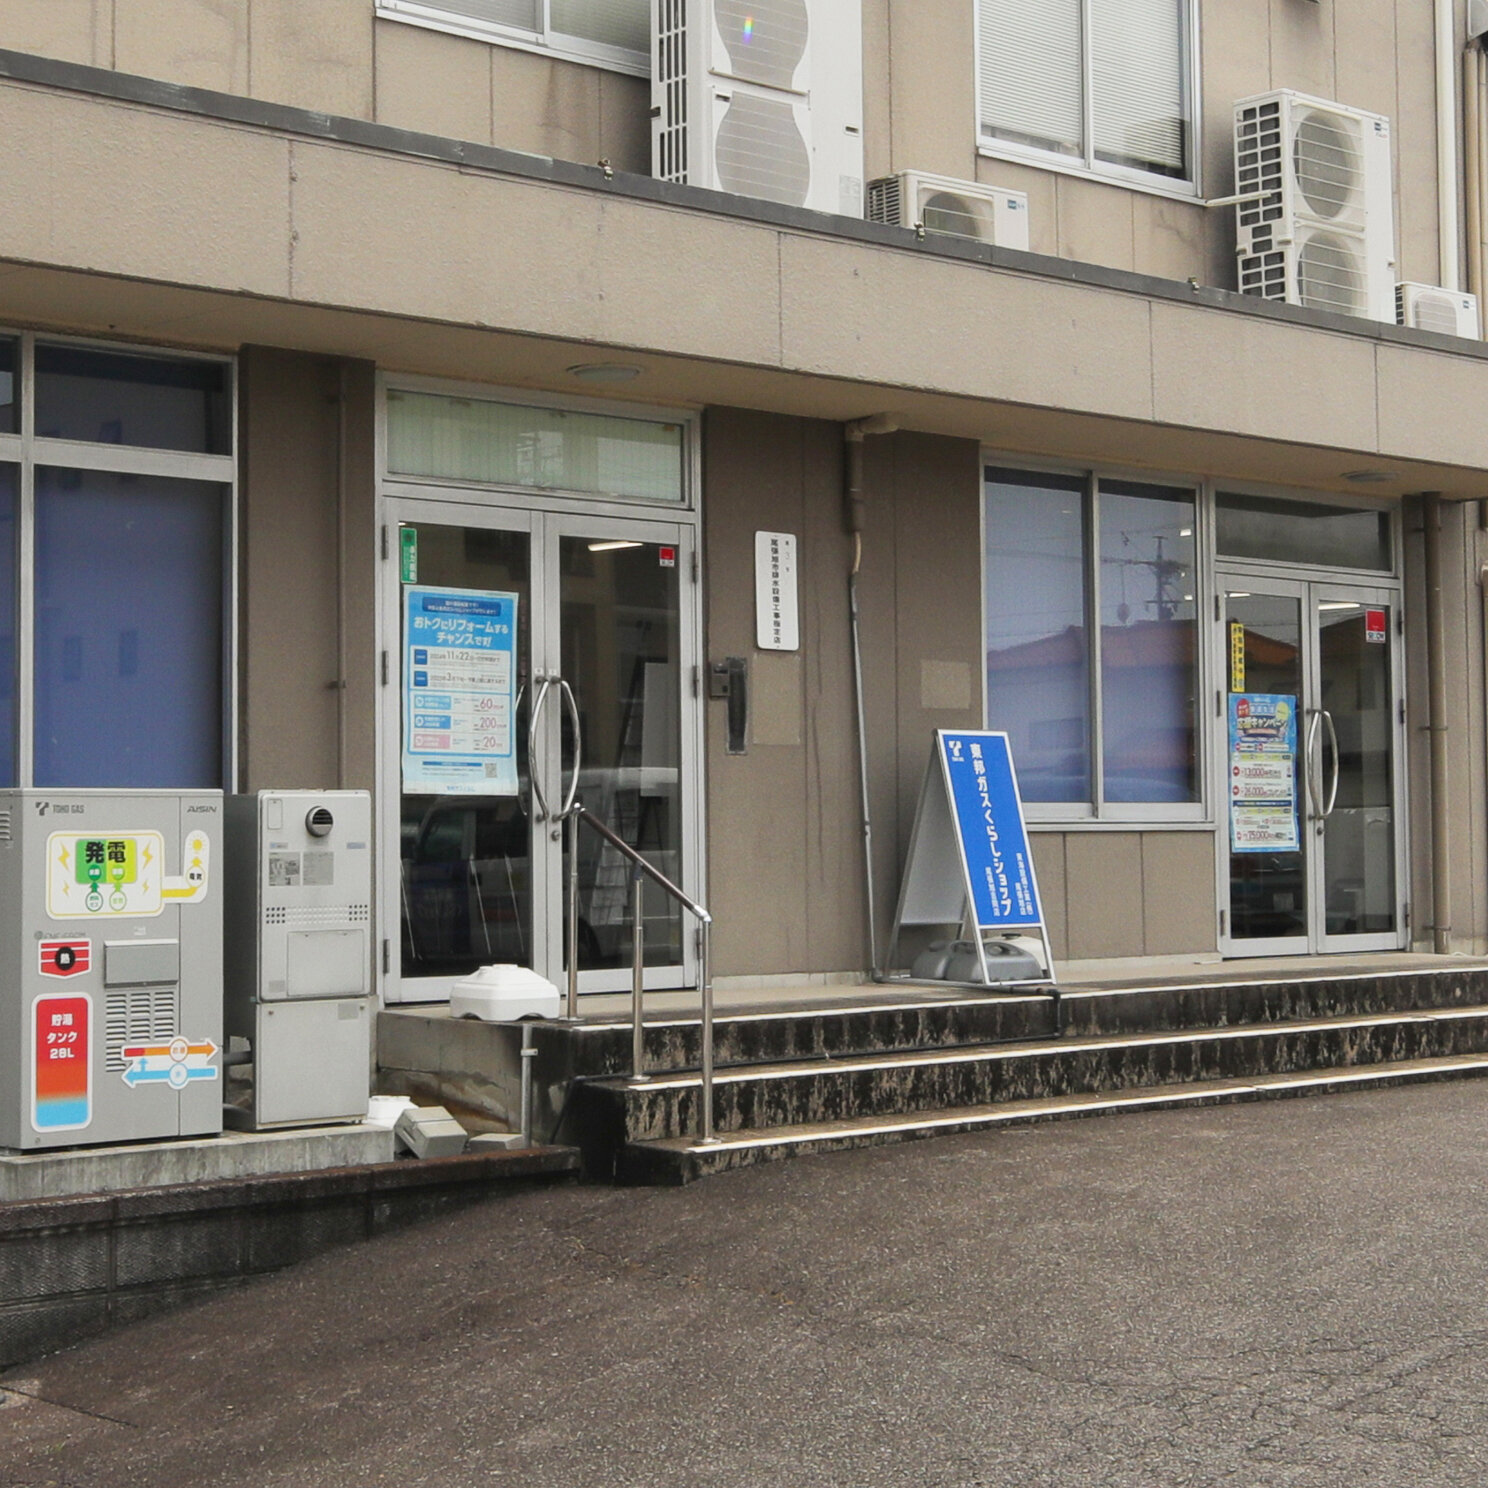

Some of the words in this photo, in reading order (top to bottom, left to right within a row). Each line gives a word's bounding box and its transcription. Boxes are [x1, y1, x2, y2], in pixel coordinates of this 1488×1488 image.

[413, 615, 510, 635] おトクにリフォームする
[970, 743, 1012, 916] 東邦ガスくらしショップ
[85, 841, 126, 864] 発電
[50, 1013, 73, 1027] 貯湯
[47, 1030, 78, 1044] タンク
